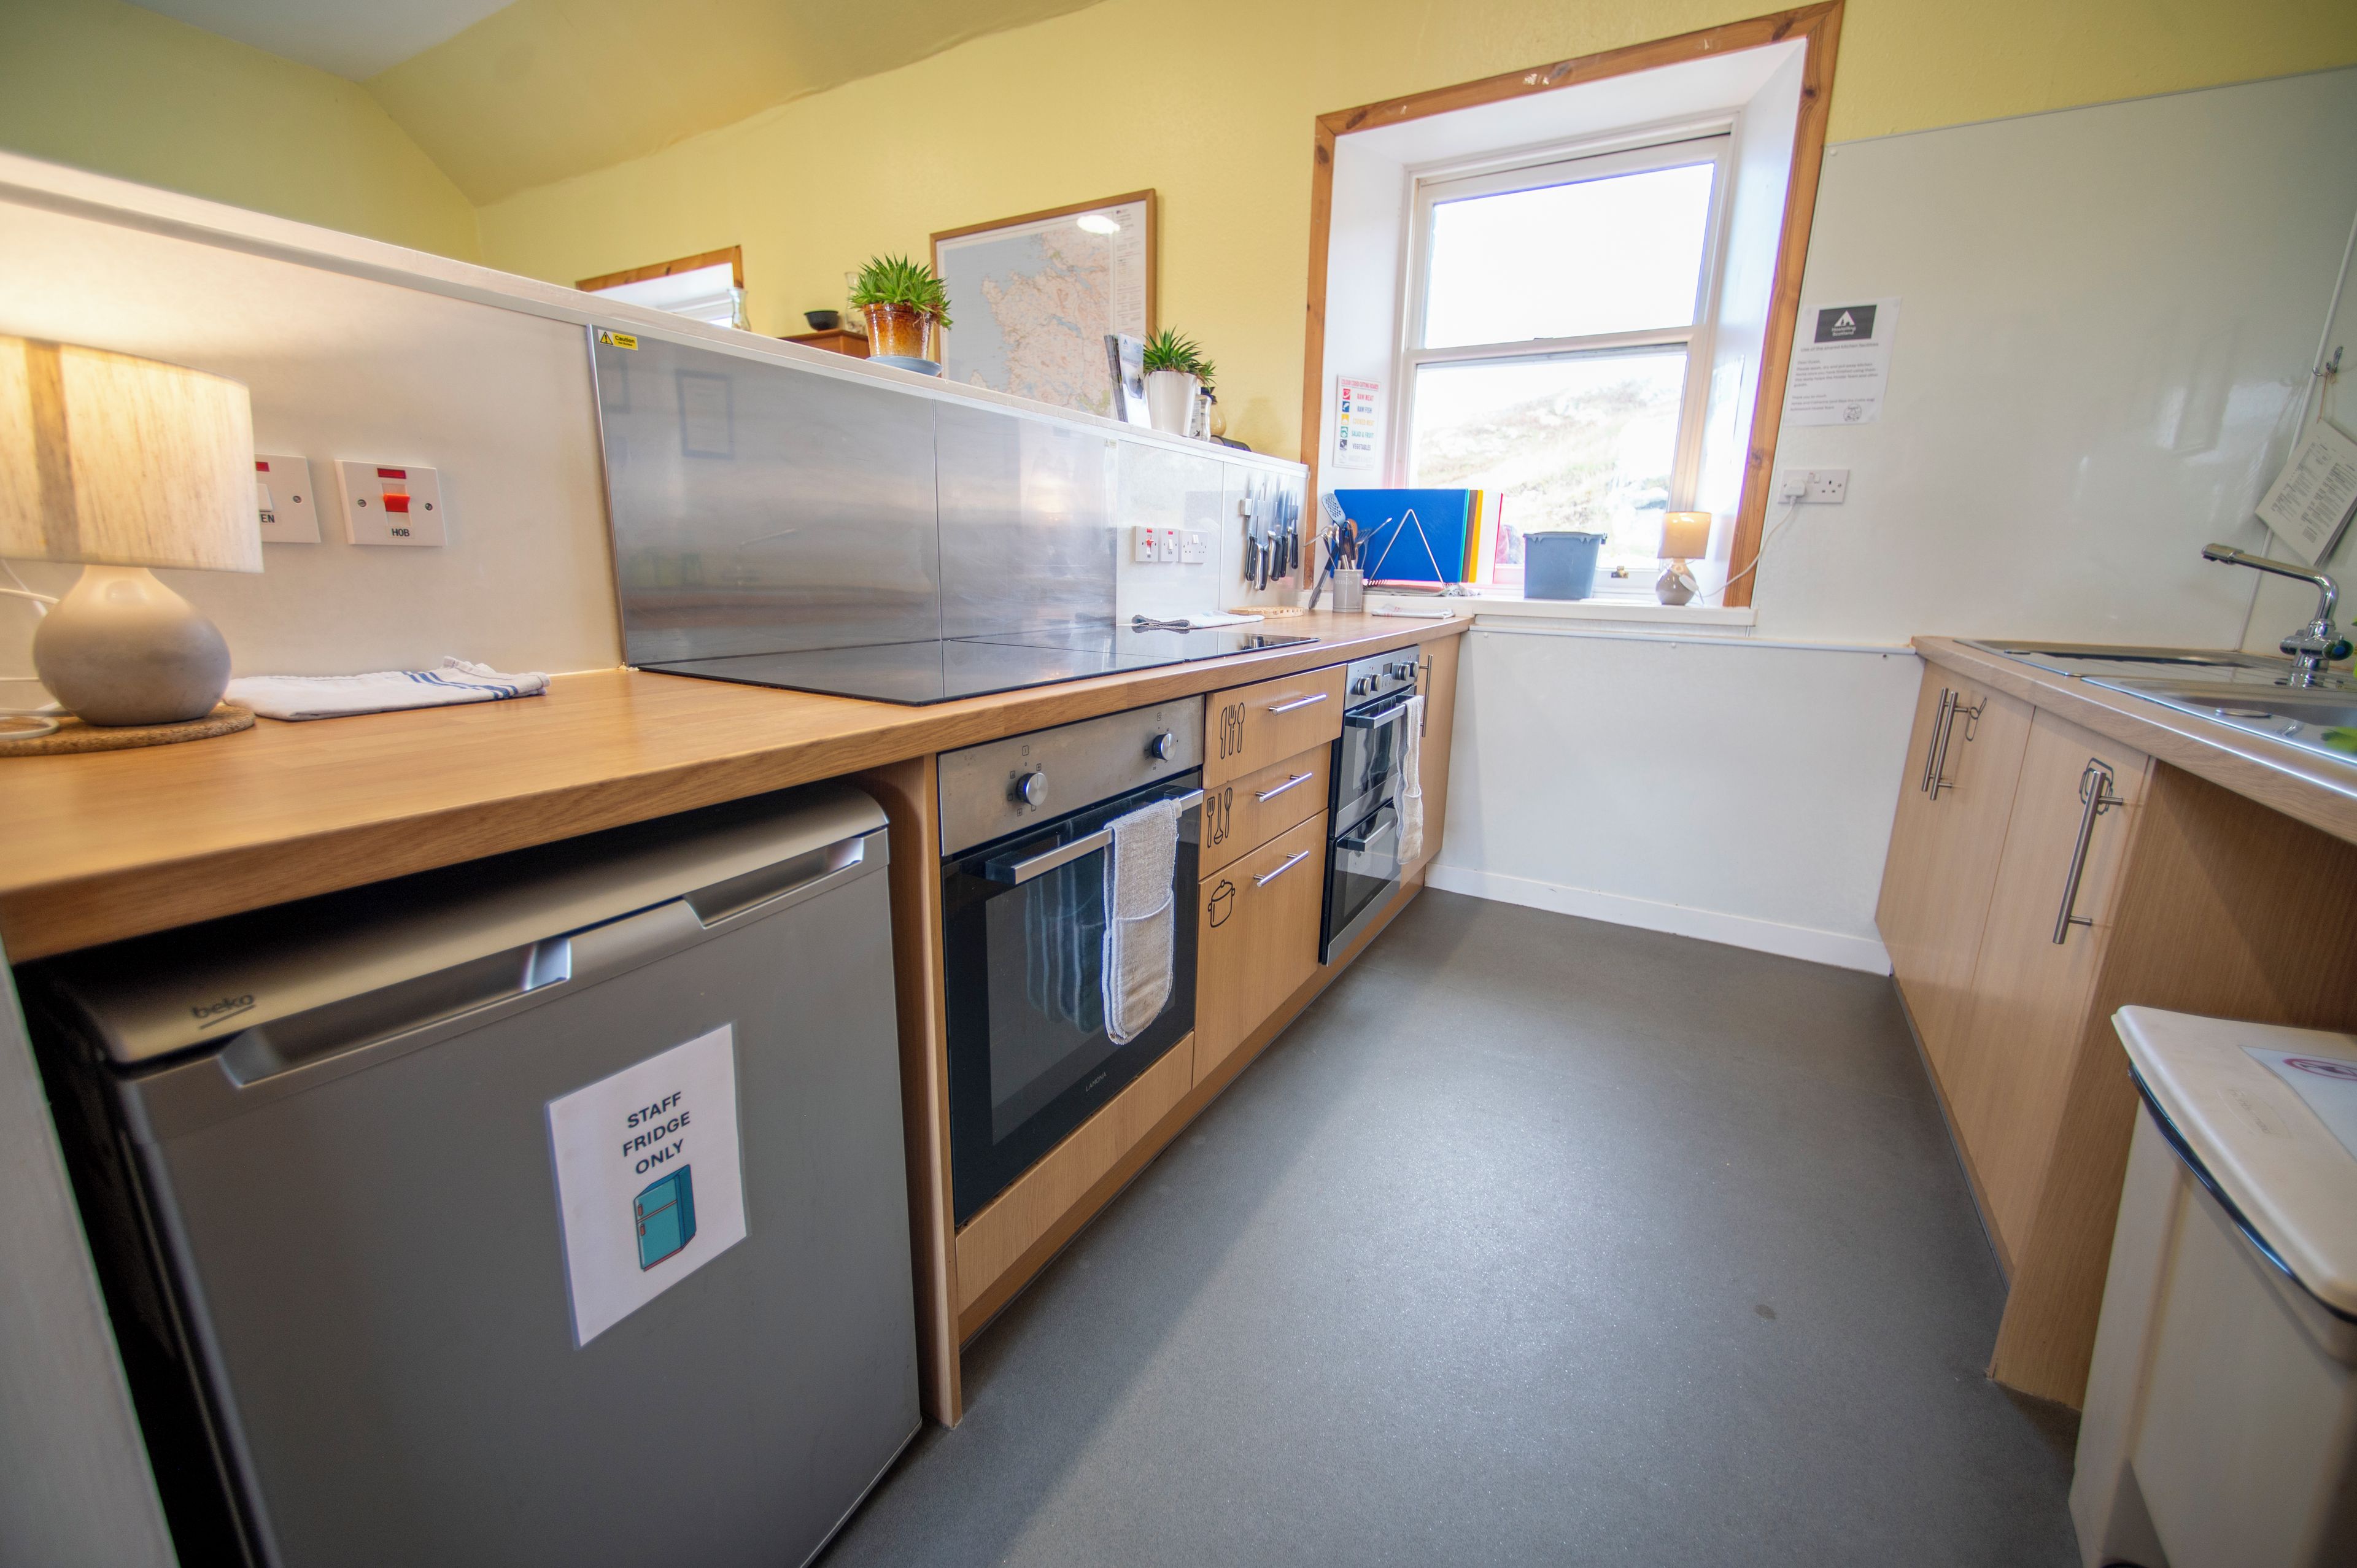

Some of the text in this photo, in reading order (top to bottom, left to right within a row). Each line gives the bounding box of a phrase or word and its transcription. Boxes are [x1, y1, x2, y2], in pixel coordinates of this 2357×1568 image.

[260, 514, 275, 523] EN
[392, 528, 410, 537] HOB
[192, 994, 254, 1018] beko
[1086, 1072, 1107, 1092] LAMONA
[627, 1091, 682, 1129] STAFF
[622, 1111, 691, 1157] FRIDGE
[635, 1138, 684, 1175] ONLY
